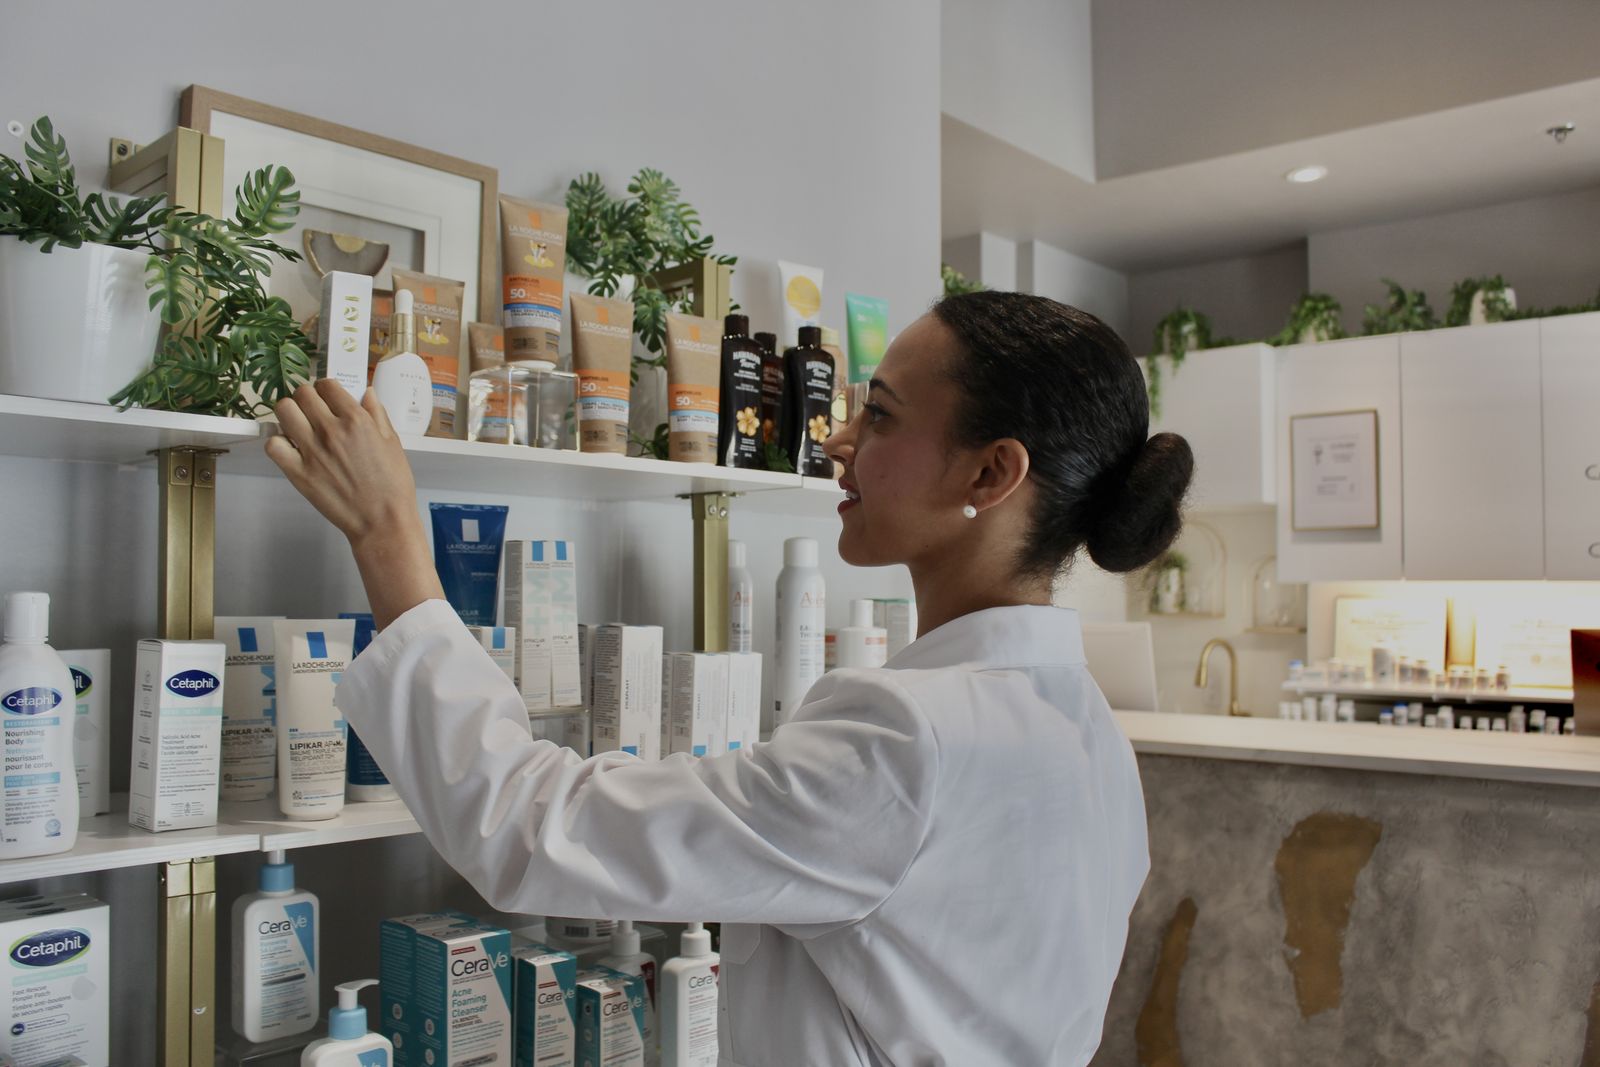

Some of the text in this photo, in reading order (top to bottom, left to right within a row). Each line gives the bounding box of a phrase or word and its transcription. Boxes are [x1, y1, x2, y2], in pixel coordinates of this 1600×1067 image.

[302, 660, 344, 669] ROCHE-POSAY
[170, 677, 214, 690] Cetaphil
[6, 693, 57, 707] Cetaphil
[5, 729, 45, 737] Nourishing
[289, 742, 322, 750] LIPIKAR
[258, 915, 307, 935] CeraVe
[17, 935, 82, 959] Cetaphil
[452, 952, 508, 977] CeraVe
[452, 988, 472, 998] Acne
[538, 988, 576, 1004] CeraVe
[452, 994, 487, 1008] Foaming
[603, 995, 642, 1016] CeraVe
[452, 1004, 488, 1018] Cleanser
